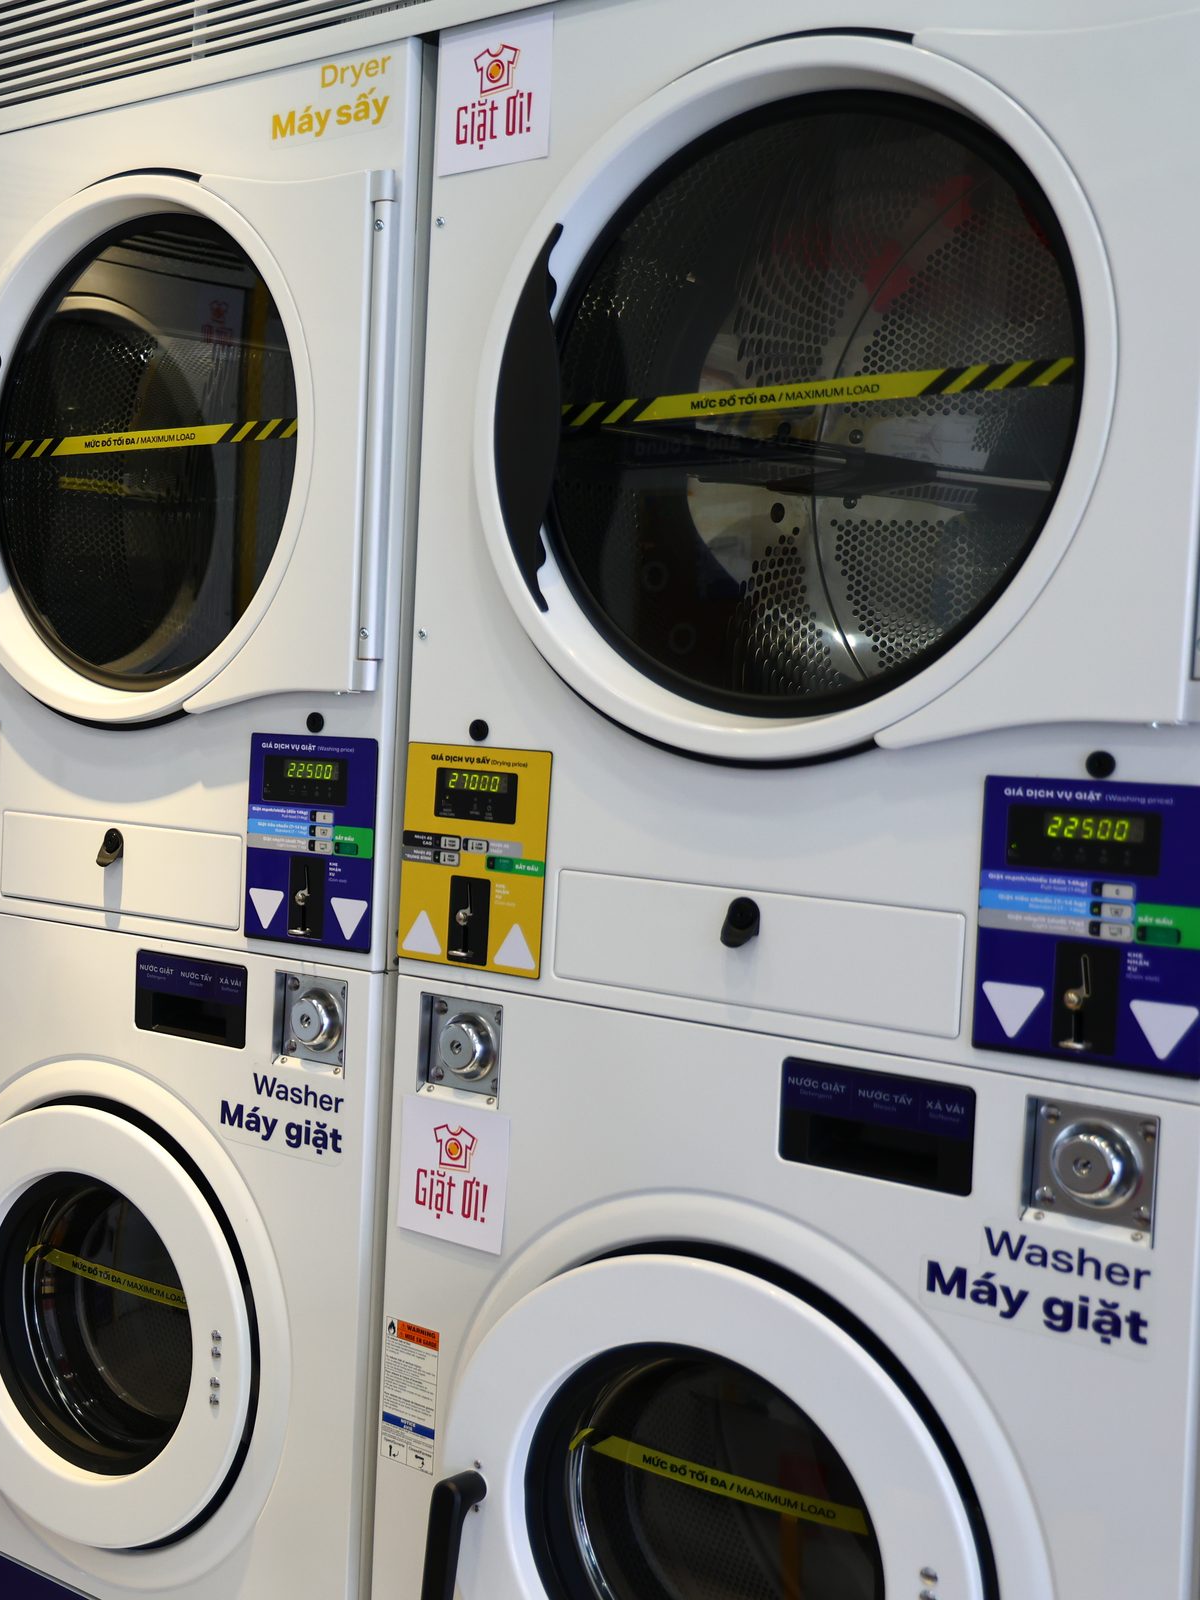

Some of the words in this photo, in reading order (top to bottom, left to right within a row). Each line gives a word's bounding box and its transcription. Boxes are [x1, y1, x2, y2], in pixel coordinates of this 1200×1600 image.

[321, 56, 391, 89] Dryer
[272, 105, 332, 140] Máy
[336, 86, 390, 125] sấy
[455, 99, 498, 150] Giặt
[759, 393, 776, 403] ĐA
[785, 386, 844, 401] MAXIMUM
[846, 383, 880, 396] LOAD
[140, 434, 175, 444] MAXIMUM
[176, 432, 196, 442] LOAD
[431, 753, 444, 761] GIÁ
[445, 755, 463, 764] DỊCH
[464, 756, 475, 765] VỤ
[491, 759, 511, 767] (Drying
[287, 762, 333, 780] 22500
[449, 772, 500, 793] 27000
[1003, 787, 1024, 797] GIÁ
[1026, 789, 1054, 799] DỊCH
[1056, 790, 1073, 801] VỤ
[1047, 816, 1130, 842] 22500
[139, 963, 158, 973] NƯỚC
[180, 971, 200, 980] NƯỚC
[787, 1075, 819, 1089] NƯỚC
[253, 1072, 344, 1113] Washer
[858, 1088, 890, 1102] NƯỚC
[220, 1099, 279, 1141] Máy
[285, 1119, 343, 1155] giặt
[415, 1167, 456, 1219] Giặt
[984, 1225, 1152, 1291] Washer
[127, 1279, 165, 1298] MAXIMUM
[926, 1259, 1030, 1320] Máy
[1042, 1294, 1148, 1346] giặt
[406, 1324, 436, 1339] WARNING
[710, 1476, 727, 1490] ĐA
[736, 1484, 799, 1511] MAXIMUM
[800, 1502, 837, 1520] LOAD
